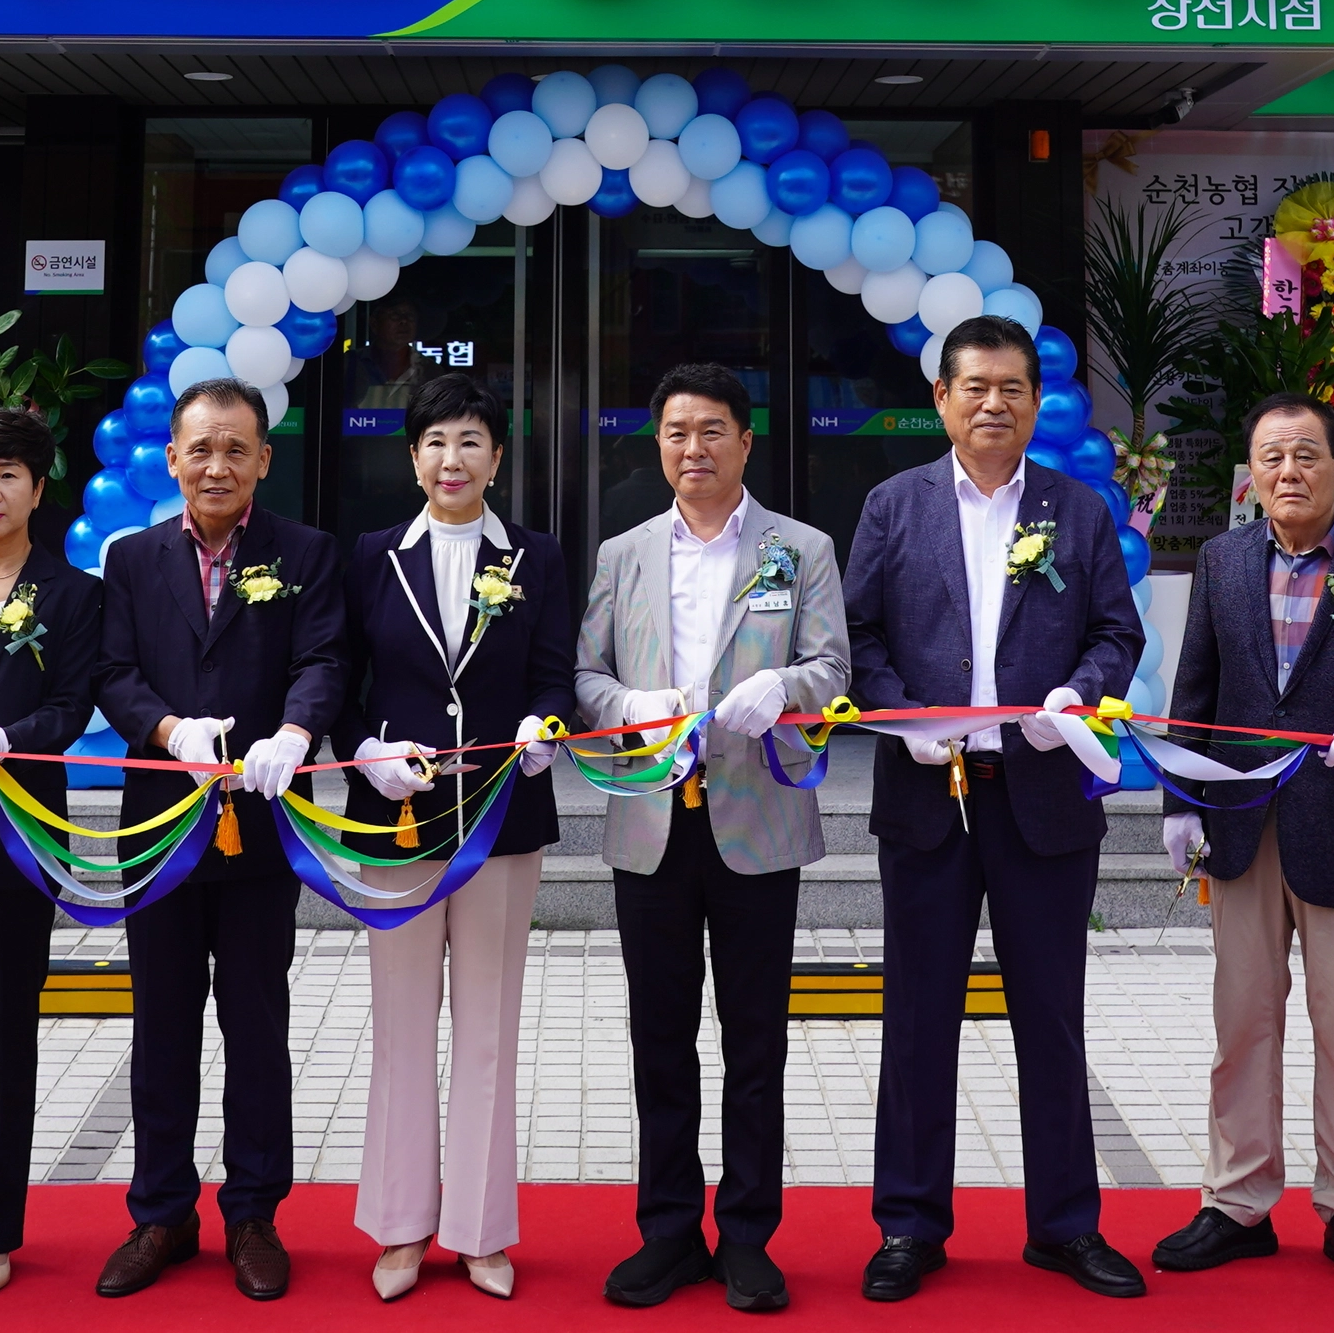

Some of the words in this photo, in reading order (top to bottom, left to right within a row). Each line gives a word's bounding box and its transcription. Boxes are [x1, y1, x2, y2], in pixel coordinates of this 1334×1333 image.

[1142, 173, 1259, 206] 순천농협
[49, 255, 97, 270] 금연시설
[349, 417, 376, 428] NH
[811, 416, 838, 427] NH
